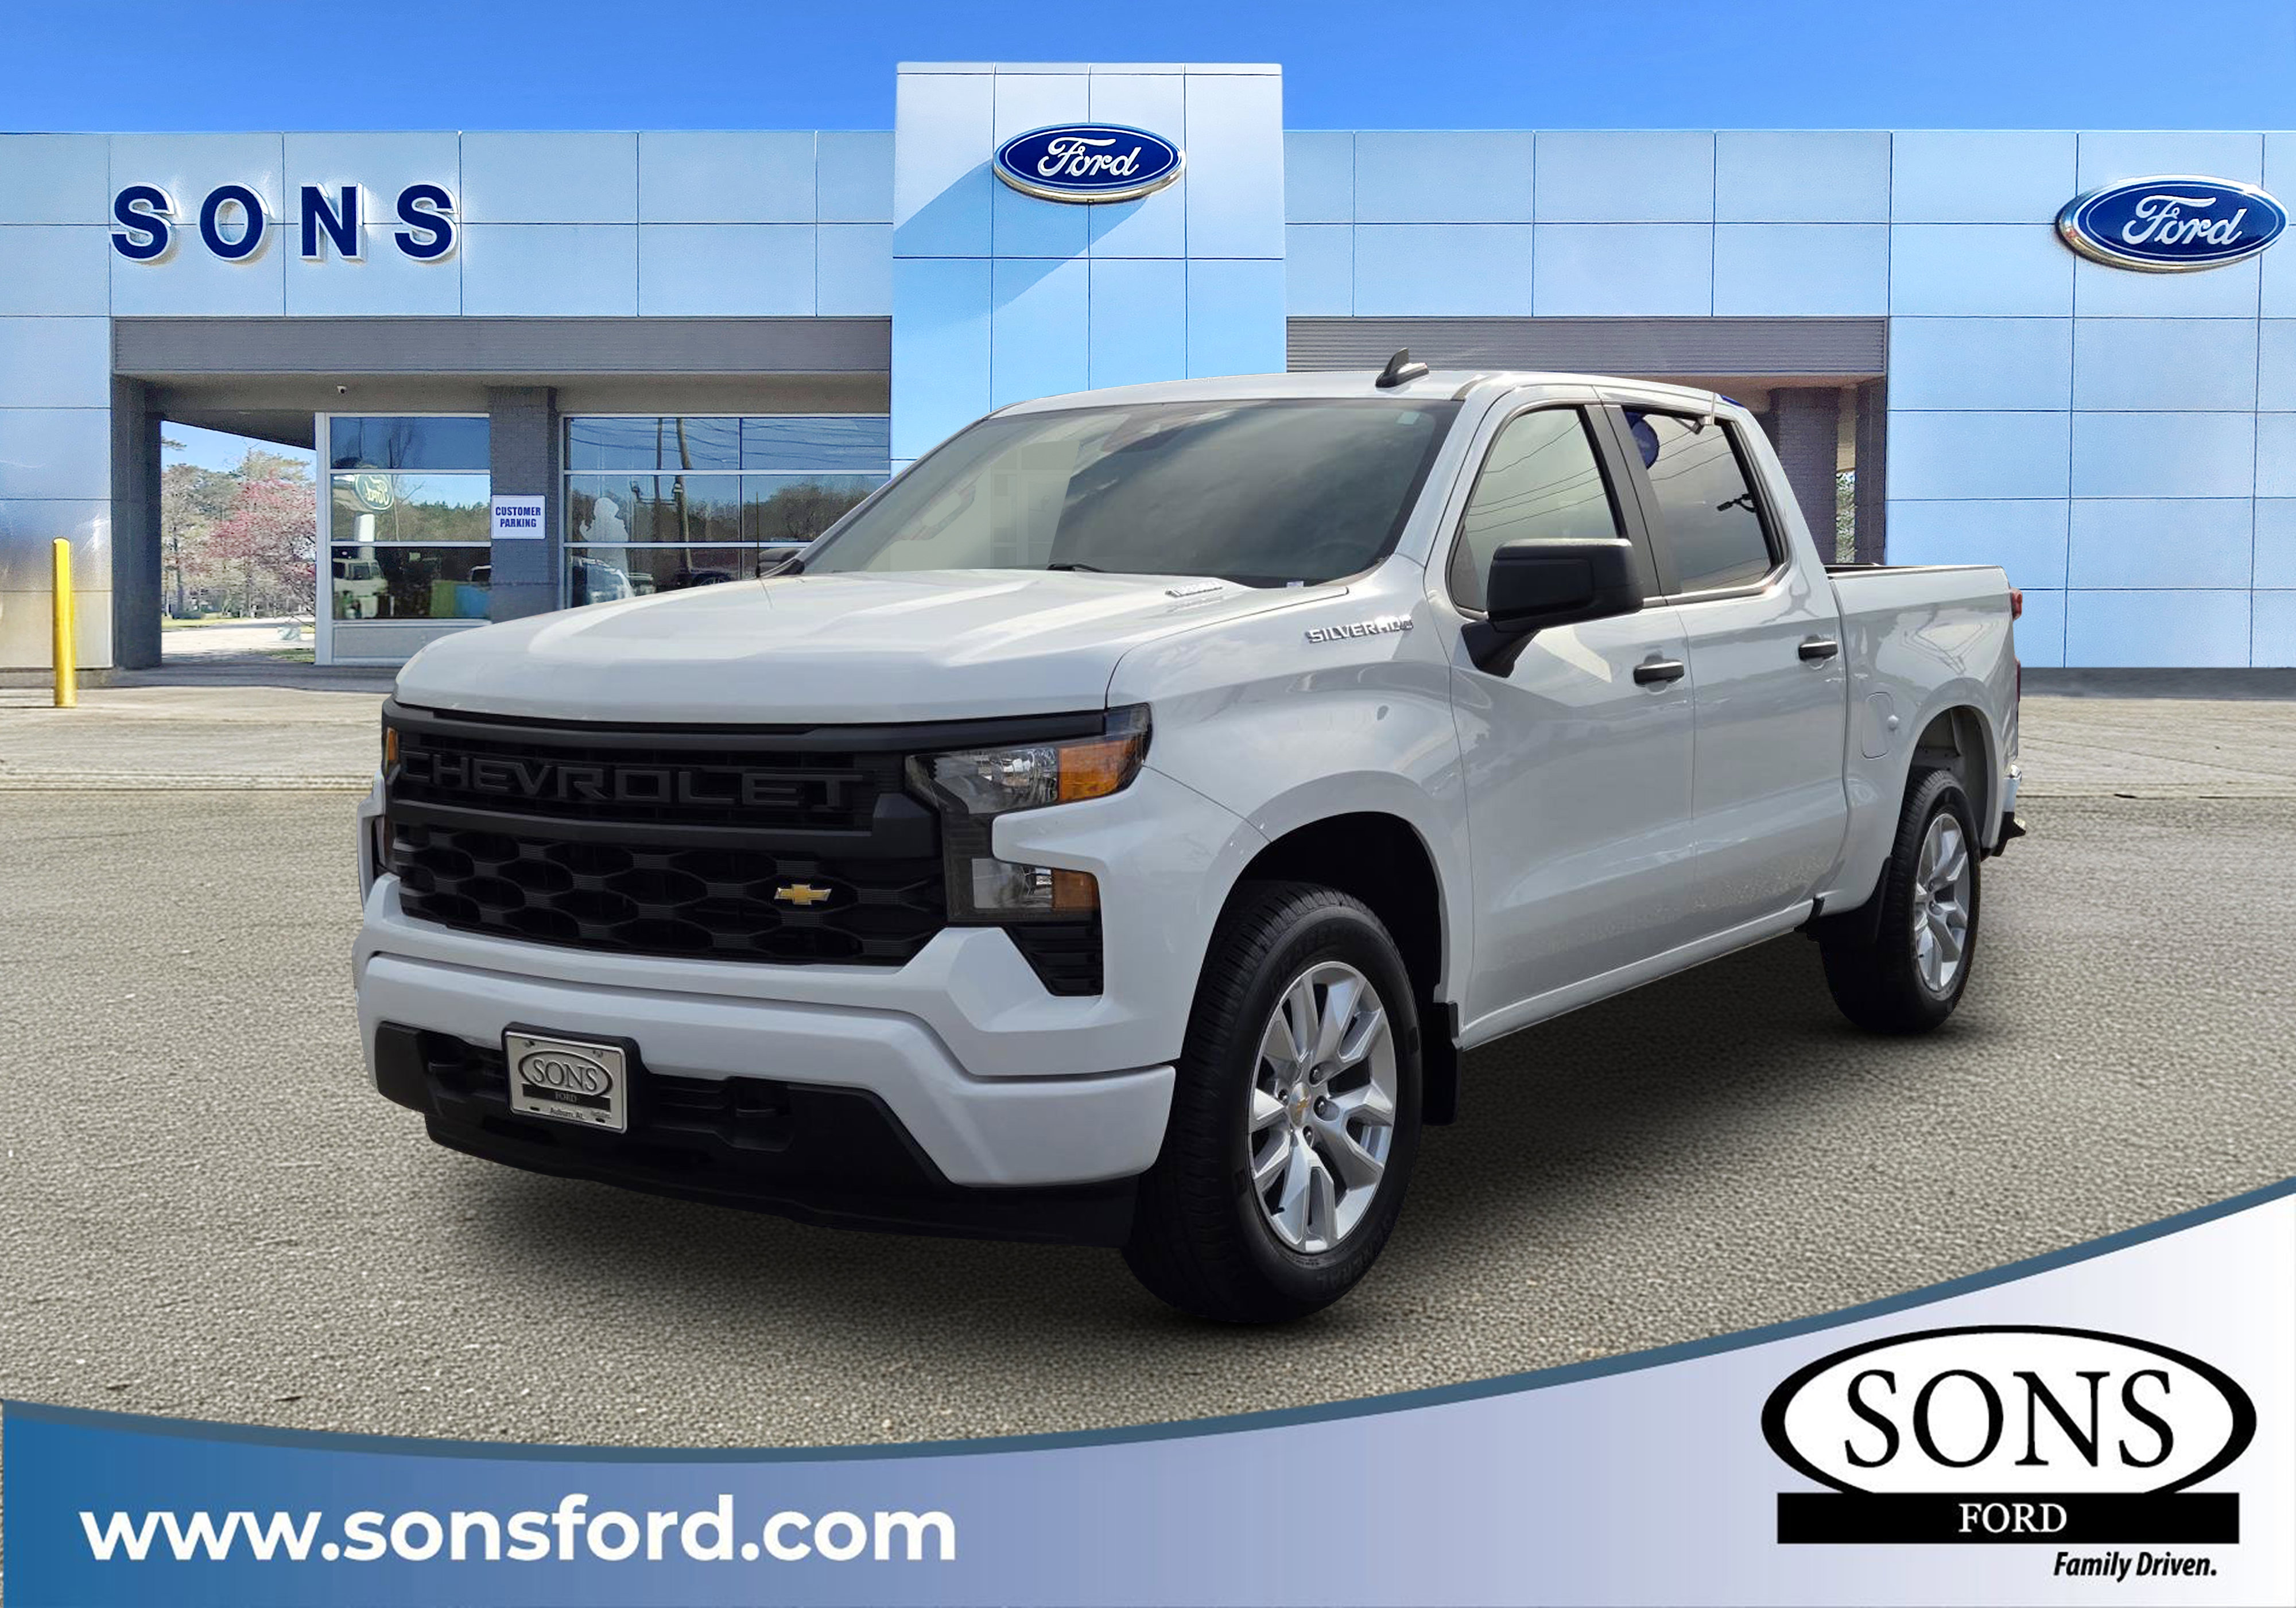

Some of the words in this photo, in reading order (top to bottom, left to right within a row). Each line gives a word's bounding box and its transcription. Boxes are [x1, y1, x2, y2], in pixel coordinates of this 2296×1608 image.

[1038, 136, 1142, 177] Ford
[111, 183, 457, 261] SONS
[2121, 195, 2247, 246] Ford
[495, 506, 541, 516] CUSTOMER
[500, 518, 537, 527] PARKING
[1306, 613, 1414, 644] SILVERADO
[400, 749, 863, 808] CHEVROLET
[533, 1057, 598, 1092] SONS
[554, 1091, 577, 1103] FORD
